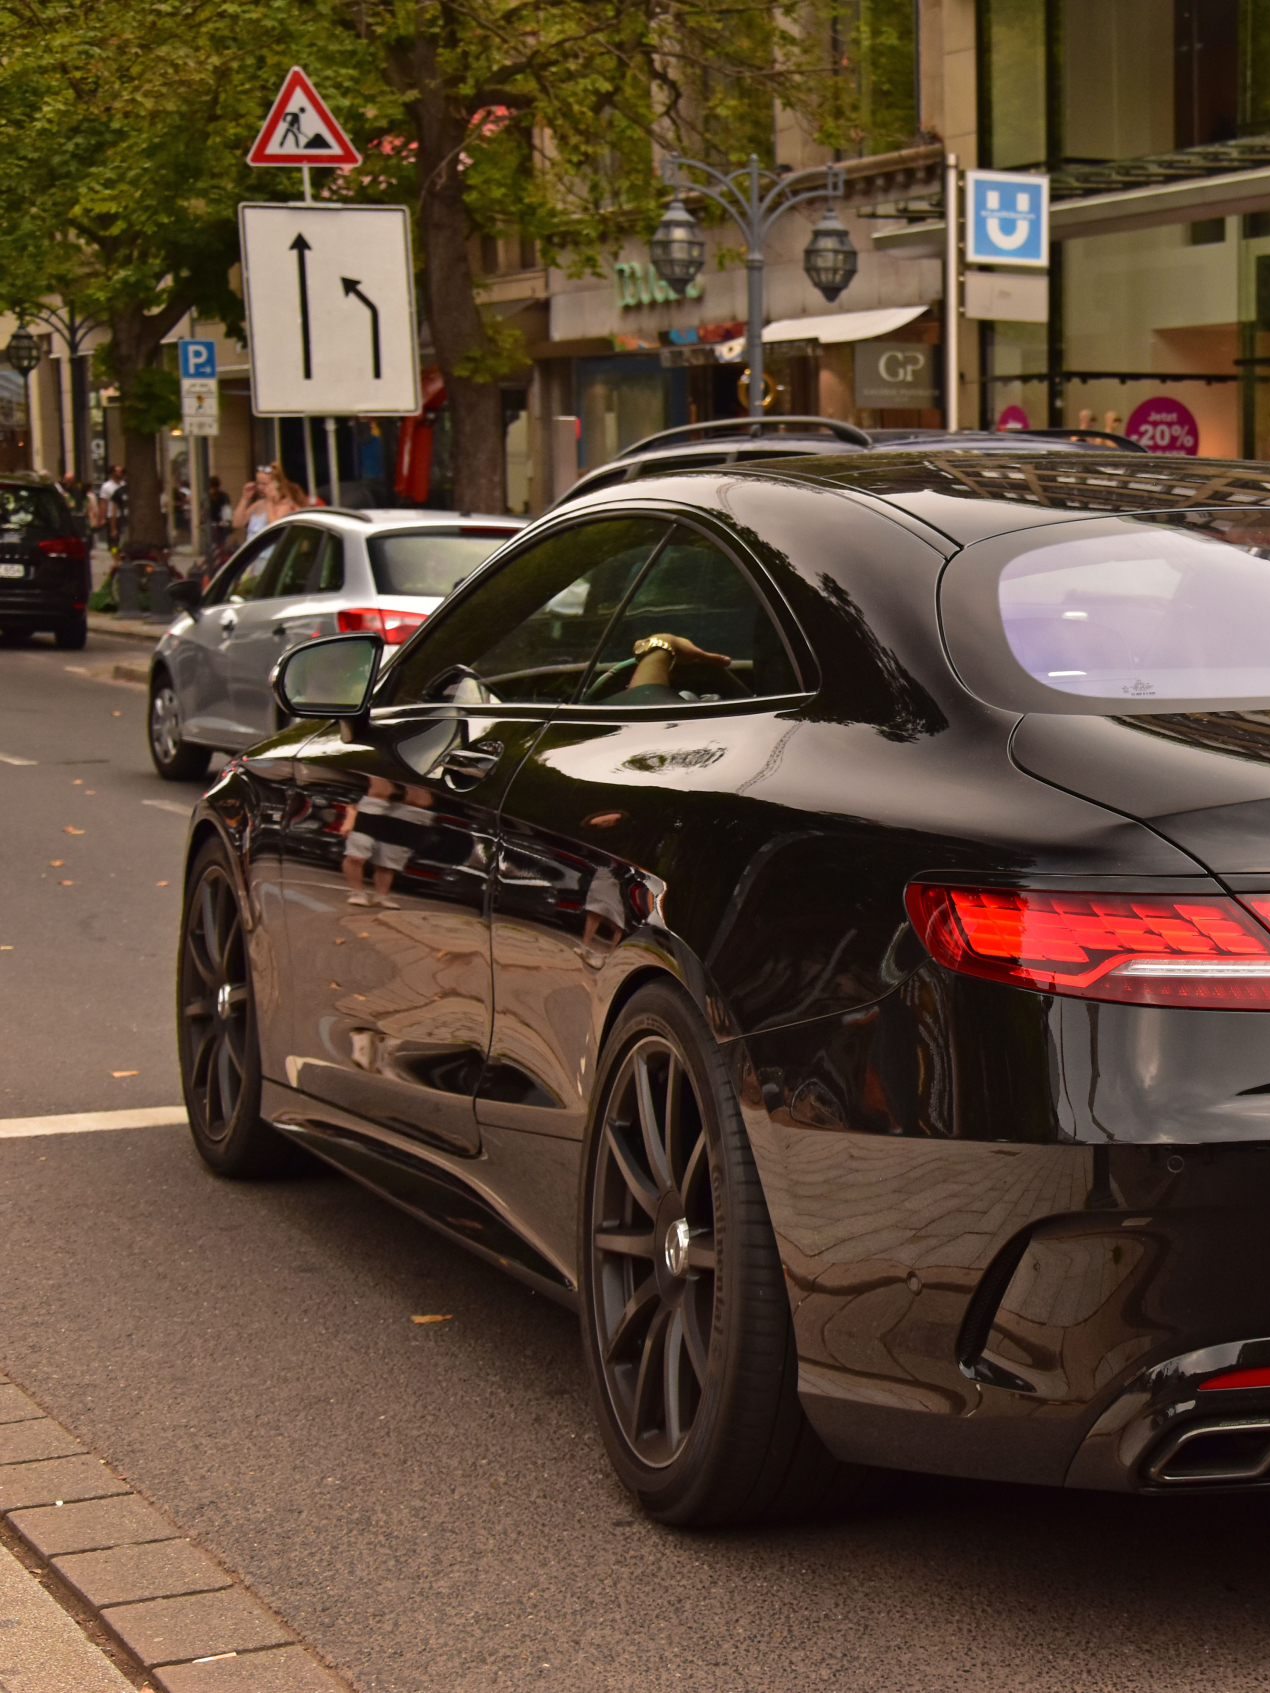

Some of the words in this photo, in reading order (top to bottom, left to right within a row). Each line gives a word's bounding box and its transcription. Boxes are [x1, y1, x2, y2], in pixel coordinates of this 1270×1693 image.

[187, 344, 208, 374] P
[878, 351, 925, 382] GP
[1147, 411, 1178, 422] Jetzt
